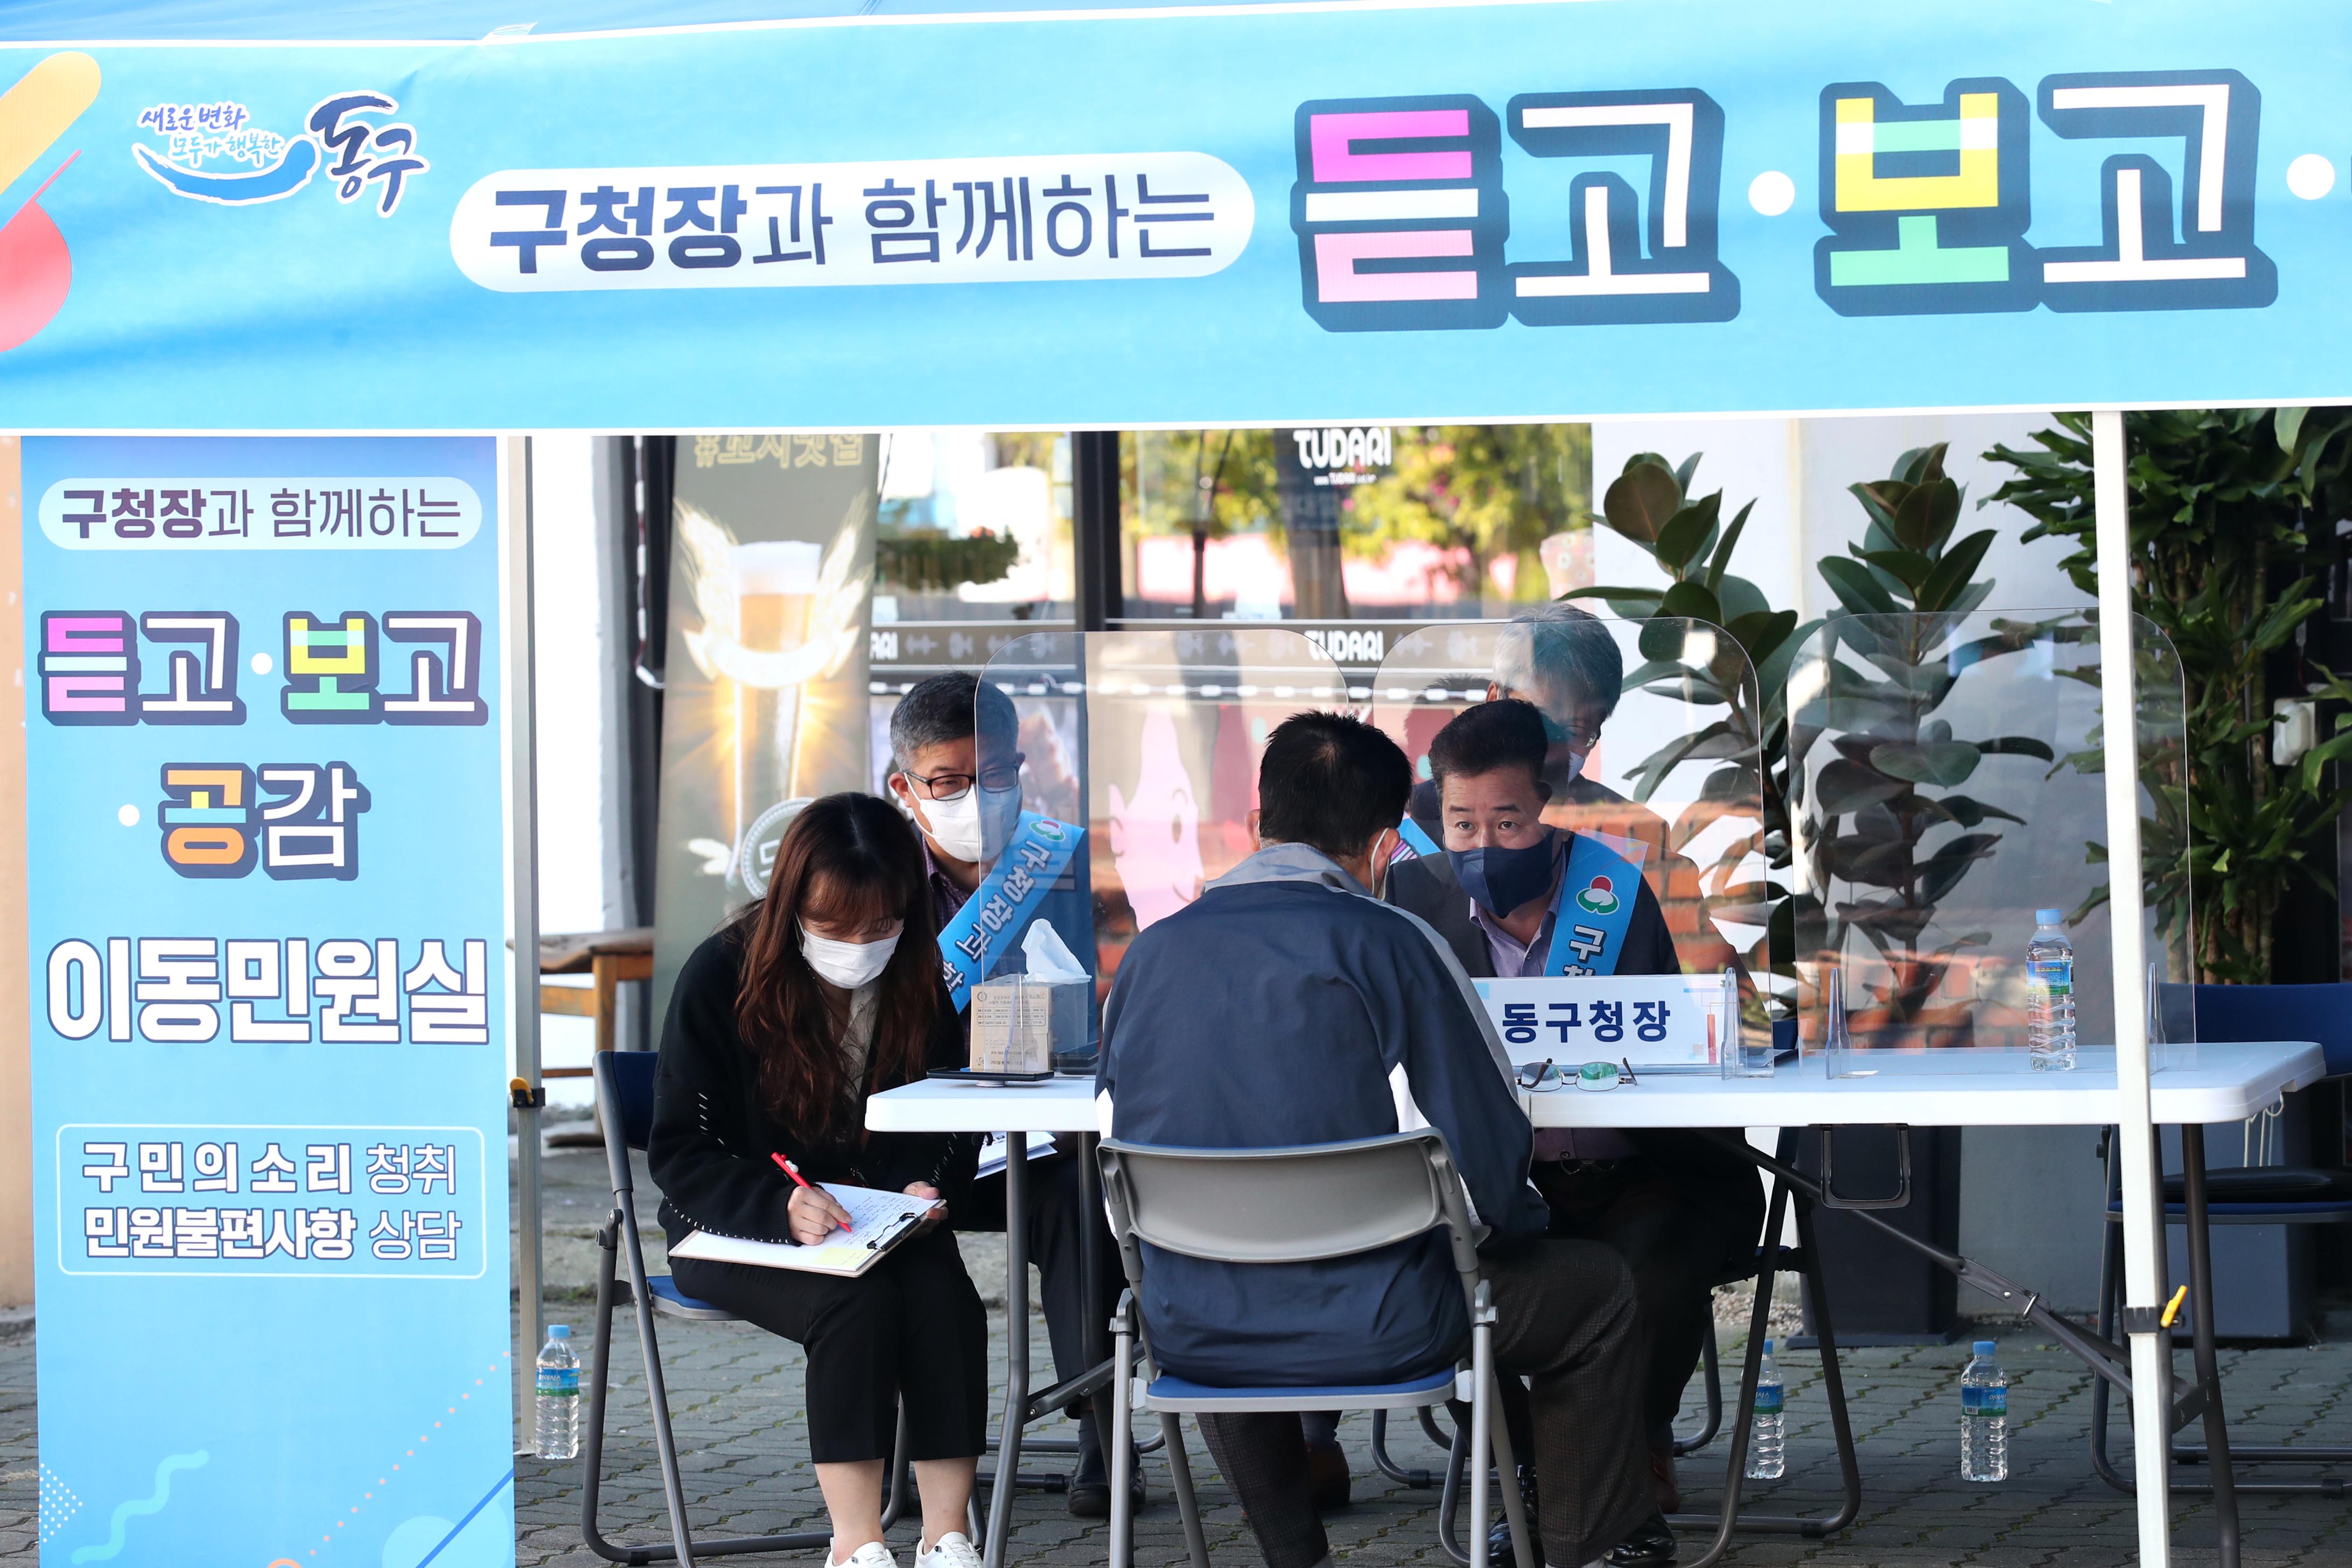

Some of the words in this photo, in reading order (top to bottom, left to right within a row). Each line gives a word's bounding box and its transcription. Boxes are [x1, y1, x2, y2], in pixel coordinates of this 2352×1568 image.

[141, 106, 198, 132] 새로운
[199, 104, 246, 130] 변화
[171, 136, 221, 164] 모두가
[227, 132, 284, 164] 행복한
[310, 95, 425, 213] 동구
[489, 183, 834, 274] 구청장과
[863, 173, 1215, 263] 함께하는
[1293, 426, 1392, 469] TUDARI
[61, 488, 254, 538] 구청장과
[270, 488, 461, 537] 함께하는
[1304, 629, 1384, 662] TUDARI
[955, 839, 1053, 965] 구청장과
[46, 937, 489, 1046] 이동민원실
[1502, 1000, 1671, 1044] 동구청장
[366, 1143, 457, 1195] 청취
[85, 1207, 358, 1261] 민원불편사항
[369, 1209, 463, 1261] 상담
